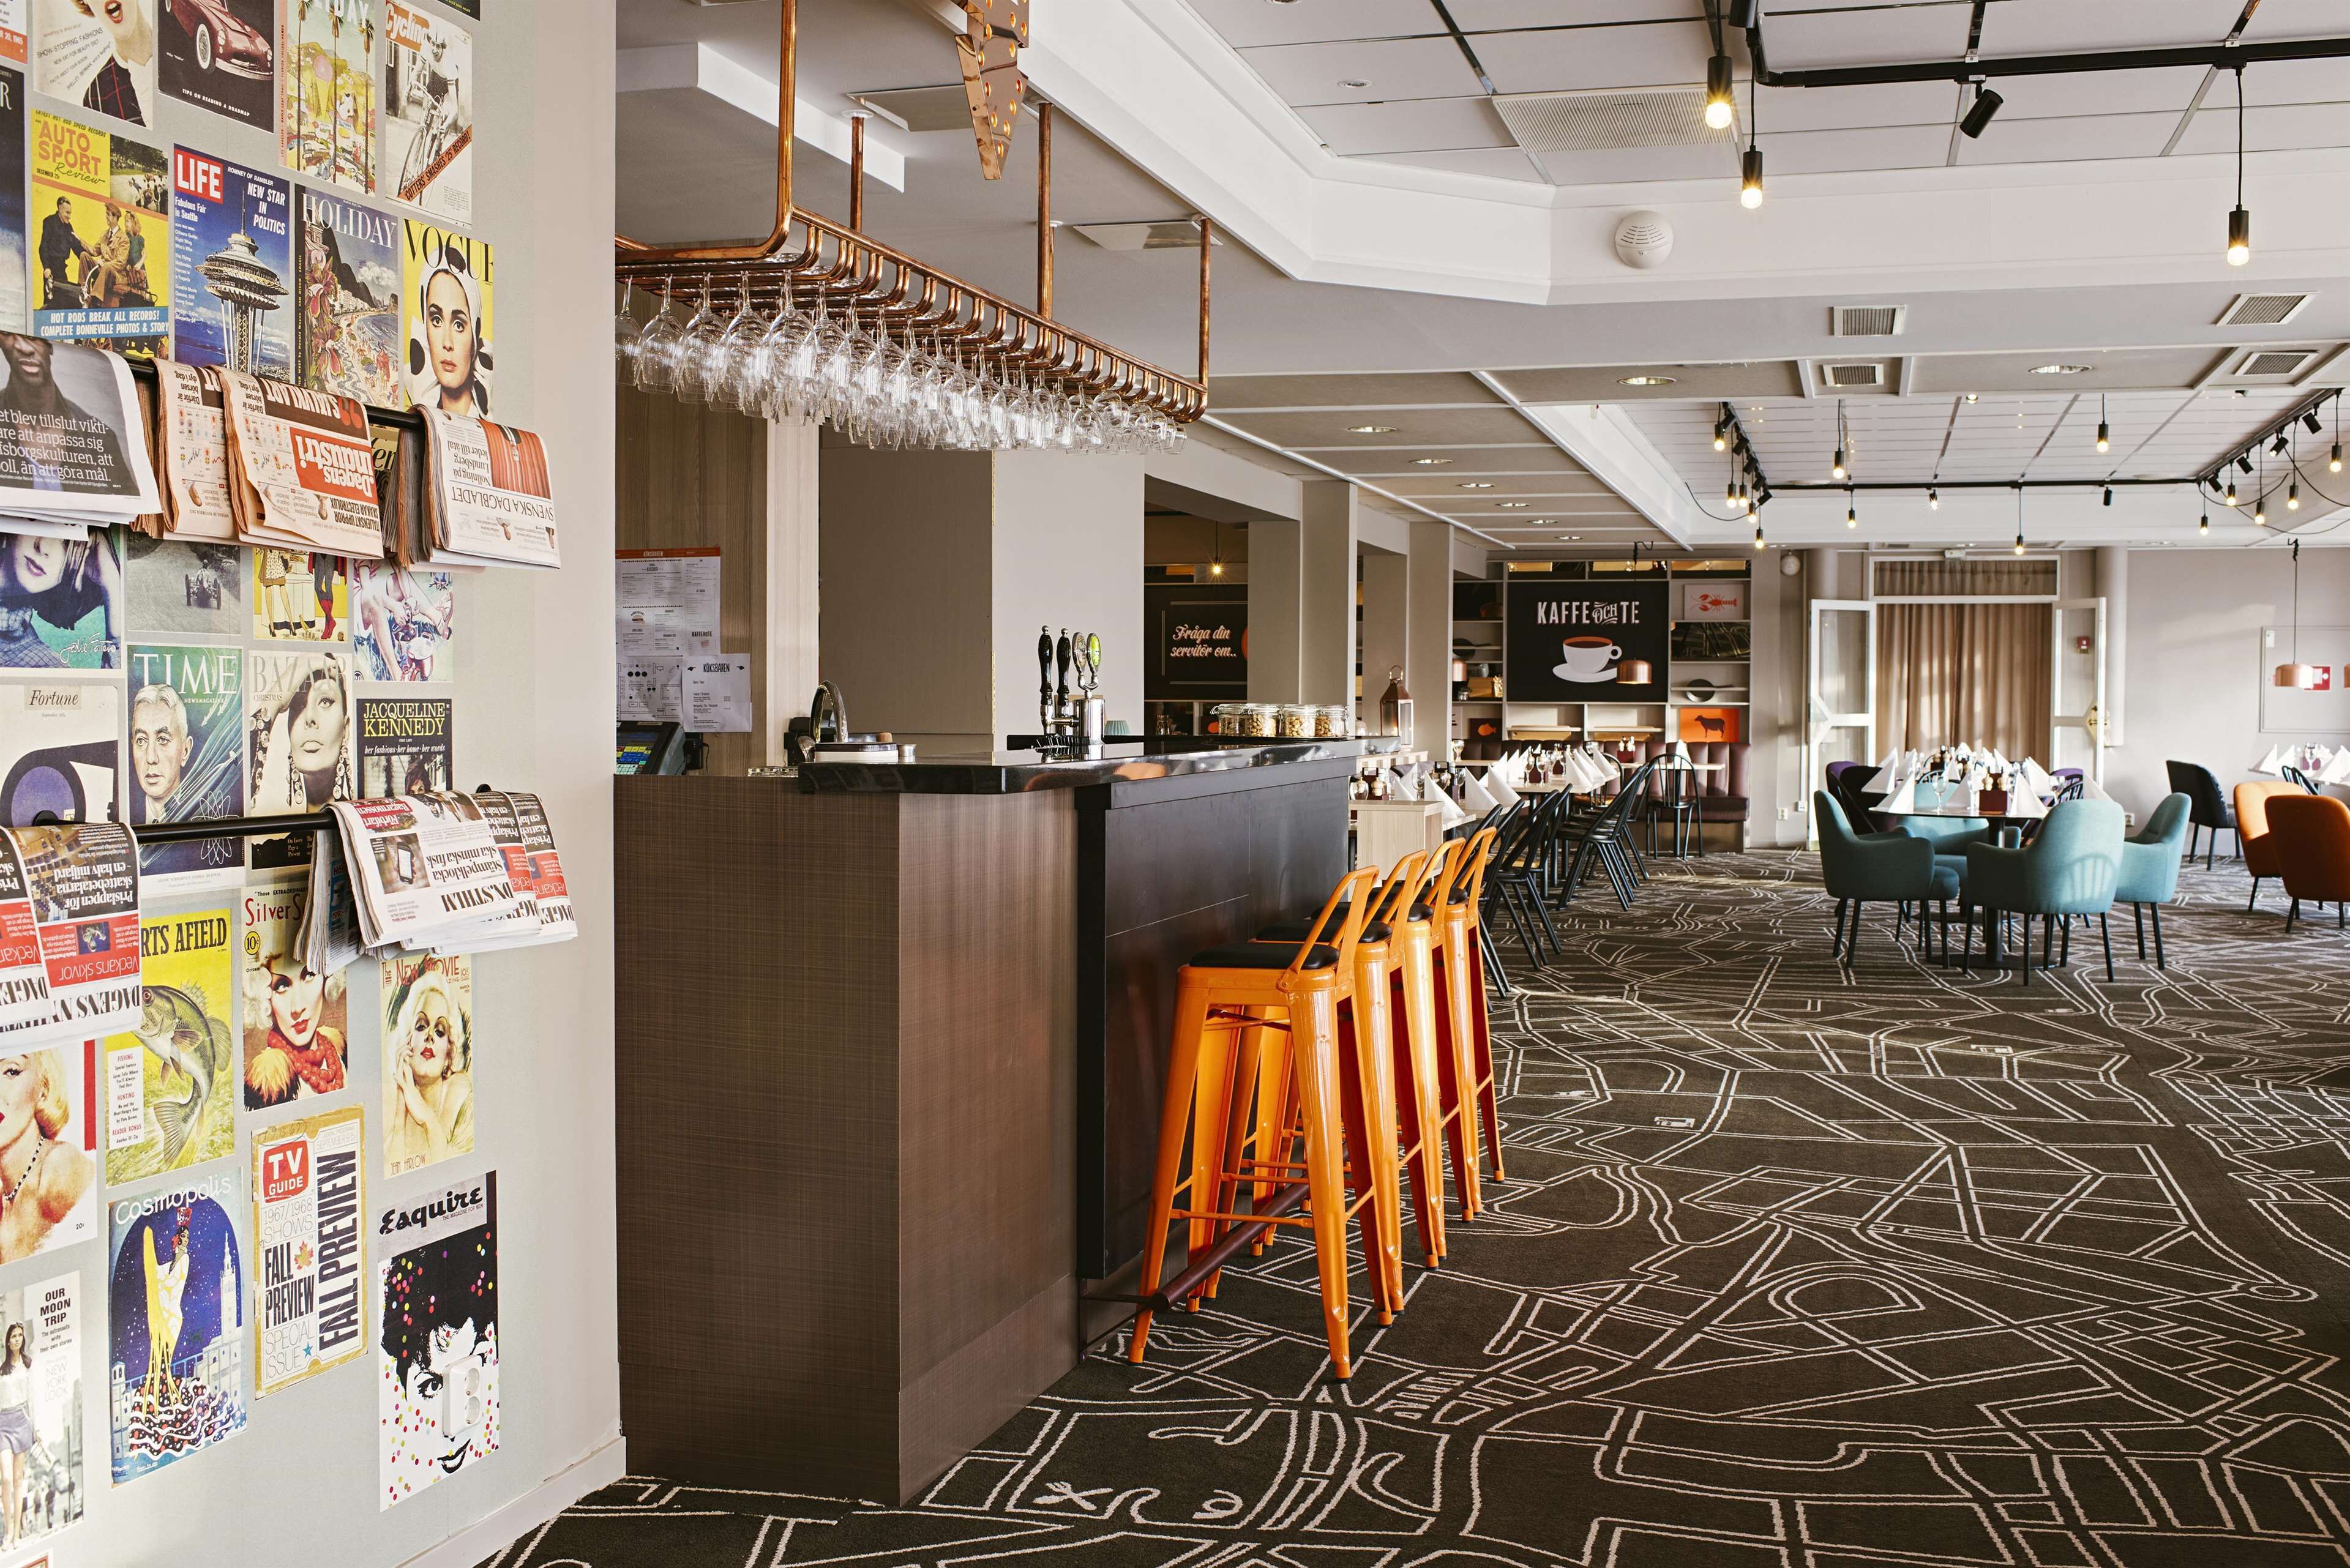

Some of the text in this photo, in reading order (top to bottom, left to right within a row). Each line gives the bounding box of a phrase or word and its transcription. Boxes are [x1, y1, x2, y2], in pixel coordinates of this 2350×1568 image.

[37, 37, 78, 58] SHOW-STOPPING
[79, 27, 103, 41] FASHIONS
[203, 96, 222, 106] READING
[228, 105, 250, 116] ROADMAP
[36, 110, 50, 118] LATEST
[73, 122, 86, 130] SPEED
[88, 127, 107, 137] RECORDS
[39, 121, 90, 152] AUTO
[39, 140, 101, 176] SPORT
[425, 130, 471, 182] SMASHES RECORD!
[54, 162, 105, 184] Review
[178, 154, 221, 199] LIFE
[228, 166, 246, 177] ROMNEY
[254, 175, 274, 186] RAMBLER
[247, 182, 285, 206] NEW STAR
[175, 196, 206, 214] Fabulous Fair
[259, 200, 267, 214] IN
[181, 210, 198, 222] Seattle
[253, 214, 285, 236] POLITICS
[301, 193, 397, 248] HOLIDAY
[403, 219, 493, 283] VOGUE
[51, 310, 159, 324] HOT RODS BREAK ALL RECORDS!
[40, 322, 168, 336] COMPLETE BONNEVILLE PHOTOS & STORY
[10, 409, 109, 434] blev tillslut vikti-
[18, 429, 104, 452] att anpassa sig
[98, 455, 114, 466] att
[461, 444, 488, 460] leder till
[21, 461, 36, 475] än
[39, 465, 56, 476] att
[58, 466, 84, 480] göra
[86, 468, 111, 482] mål.
[454, 454, 489, 473] Lundsberg
[323, 466, 374, 498] Dagens
[462, 468, 490, 486] Nollning
[330, 497, 378, 518] SKAKAR ELECTROLUX
[452, 487, 554, 521] SVENSKA DAGBLADET
[1538, 602, 1640, 624] KAFFE OCH TE
[1173, 624, 1231, 644] Fråga din
[1170, 644, 1212, 657] servitör
[133, 653, 237, 693] TIME
[251, 656, 348, 692] BAZAAR
[703, 663, 730, 673] KÖKSBAREN
[29, 690, 78, 706] Fortune
[364, 703, 445, 719] JACQUELINE
[364, 718, 445, 737] KENNEDY
[374, 745, 395, 755] fashions
[426, 846, 496, 868] ska minska fusk
[53, 862, 126, 882] en halv miljard
[432, 860, 503, 883] Stämpelklocka
[56, 876, 132, 894] skattebetalarna
[63, 890, 133, 910] Prislappen för
[441, 882, 514, 912] DN.STHLM
[245, 898, 291, 927] Silver
[174, 917, 227, 953] AFIELD
[59, 956, 139, 980] Veckans skivor
[77, 985, 140, 1018] DAGENS
[118, 1053, 133, 1062] FISHING
[117, 1092, 135, 1101] HUNTING
[113, 1127, 127, 1136] READER
[269, 1147, 303, 1180] TV
[405, 1153, 426, 1170] HARLOW
[269, 1176, 303, 1196] GUIDE
[116, 1174, 231, 1225] Cosmopolis
[264, 1198, 313, 1225] 1967/1968
[379, 1187, 482, 1235] Esquire
[450, 1209, 467, 1218] MAGAZINE
[264, 1214, 313, 1244] SHOWS
[317, 1151, 358, 1351] FALL PREVIEW
[265, 1242, 294, 1288] FALL
[45, 1288, 65, 1302] OUR
[266, 1274, 315, 1329] PREVIEW
[40, 1297, 71, 1316] MOON
[44, 1312, 67, 1327] TRIP
[50, 1324, 70, 1335] astronauts
[59, 1338, 72, 1347] stories
[266, 1320, 315, 1355] SPECIAL
[45, 1361, 67, 1376] NEW
[266, 1346, 301, 1379] ISSUE
[45, 1387, 68, 1403] LOOK
